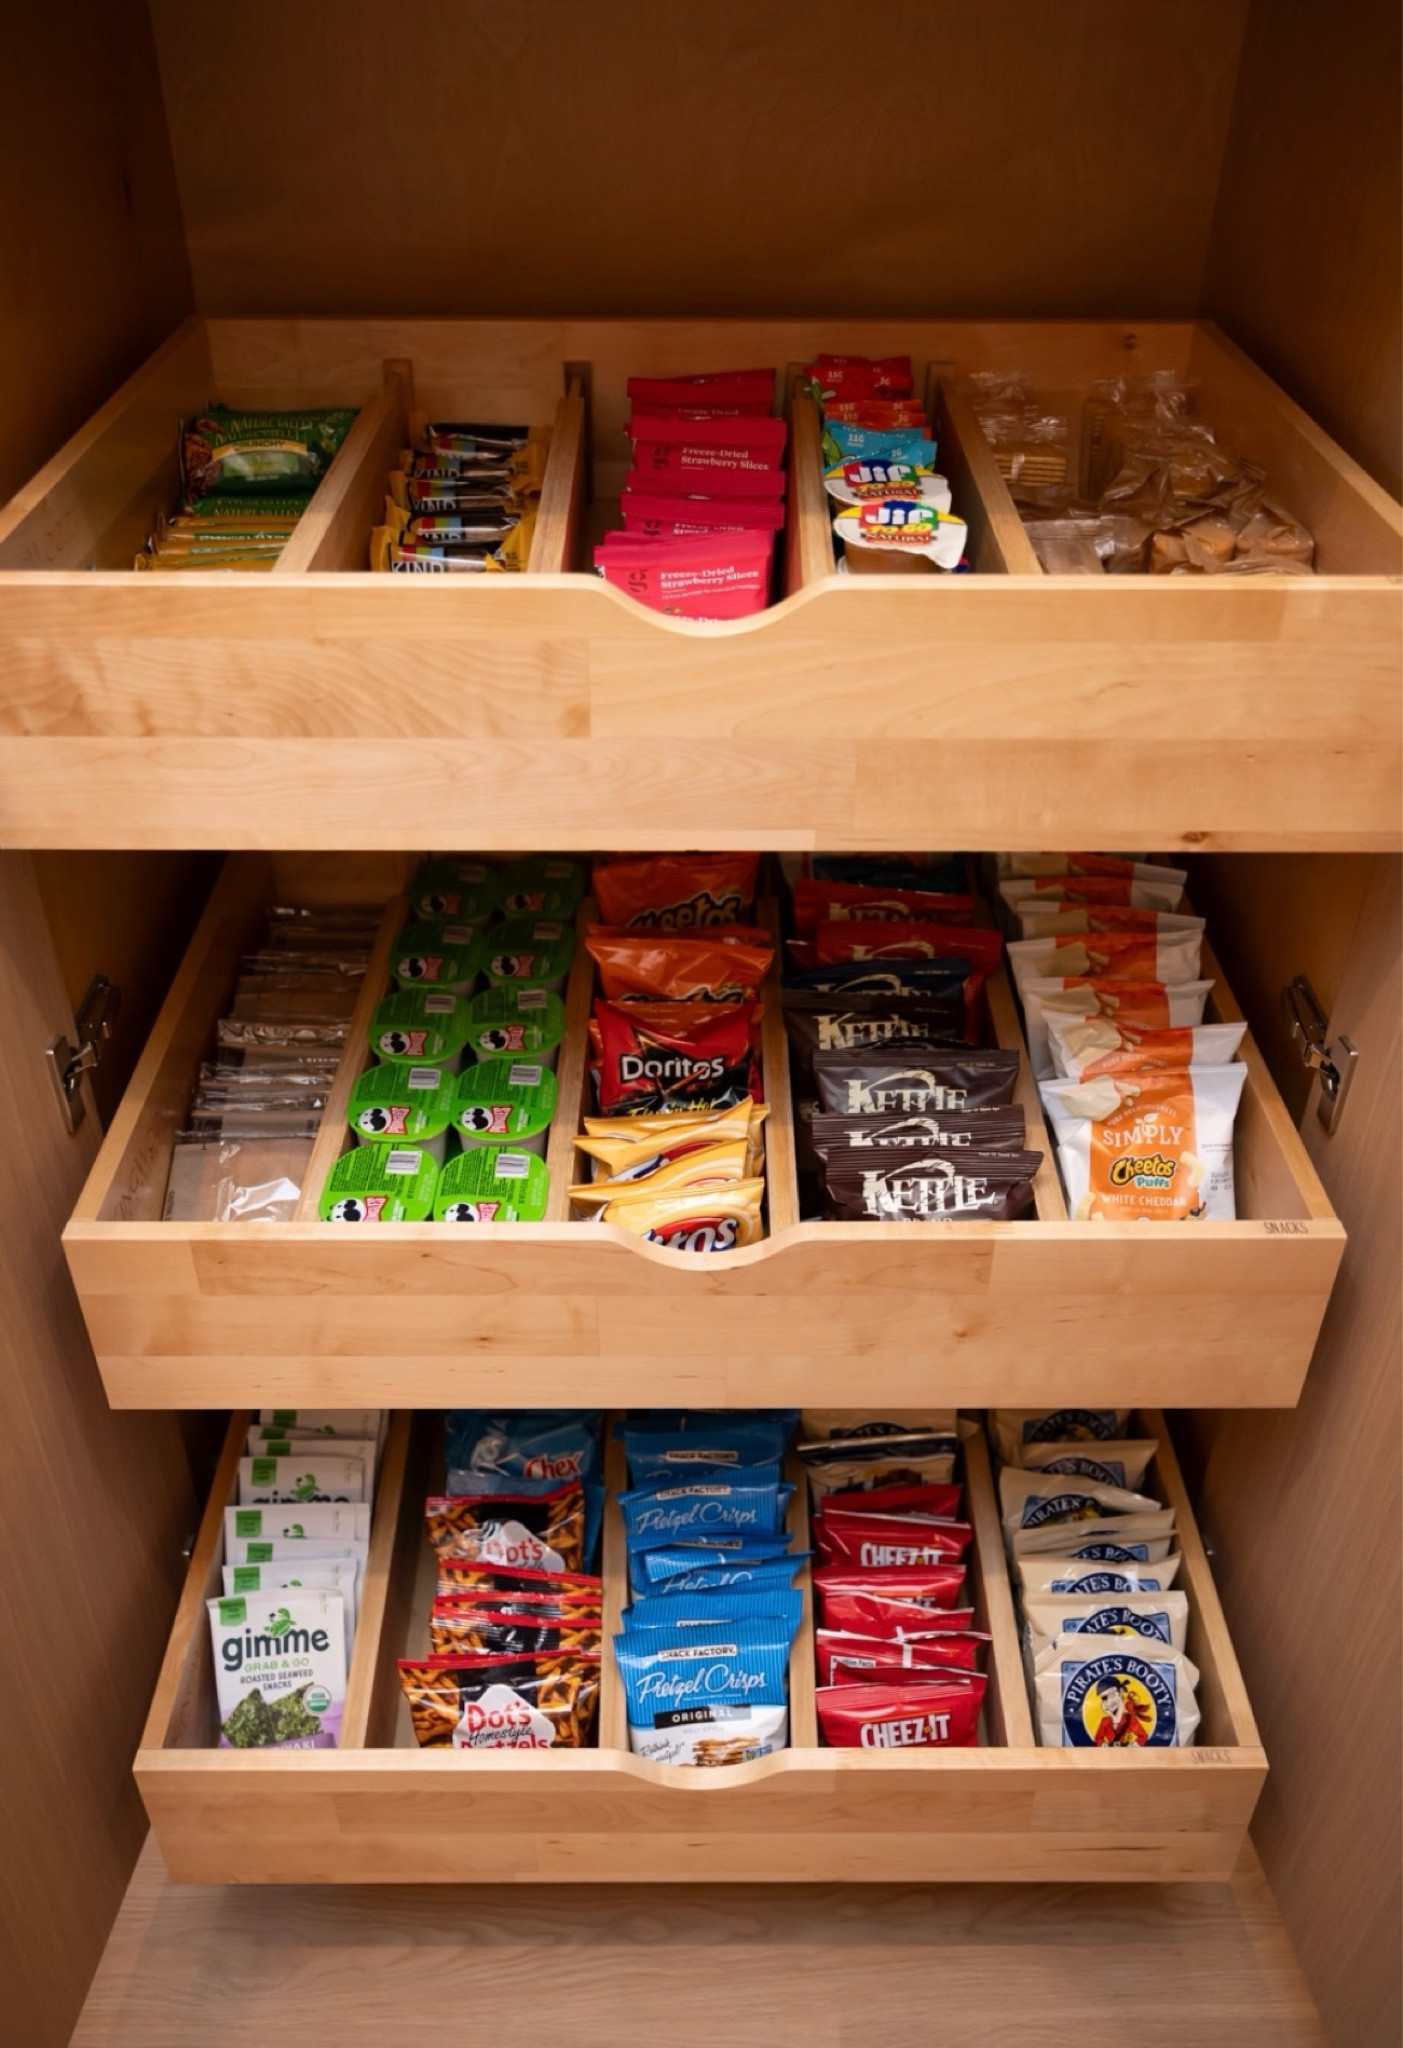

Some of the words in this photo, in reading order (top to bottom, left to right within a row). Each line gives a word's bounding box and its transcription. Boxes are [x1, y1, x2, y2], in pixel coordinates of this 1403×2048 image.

[681, 455, 738, 470] Strawberry
[739, 459, 770, 471] Slices
[620, 1055, 725, 1081] Doritos
[1102, 1123, 1184, 1148] SIMPLY
[1109, 1153, 1176, 1186] Cheetos
[1101, 1193, 1136, 1205] WHITE
[1138, 1195, 1187, 1207] CHEDDAR
[523, 1451, 583, 1480] Chex
[486, 1537, 543, 1563] Dot's
[222, 1627, 330, 1672] gimme
[661, 1650, 691, 1659] SNACK
[240, 1673, 276, 1685] ROASTED
[278, 1669, 314, 1681] SEAWEED
[245, 1660, 278, 1673] GRAB
[281, 1660, 290, 1669] &
[292, 1657, 310, 1667] GO
[263, 1681, 292, 1692] SNACKS
[635, 1667, 706, 1708] Pretzel
[704, 1663, 767, 1696] Crisps
[1066, 1658, 1122, 1703] PIRATE'S
[1126, 1660, 1173, 1705] BOOTY
[467, 1701, 532, 1732] Dot's
[671, 1709, 734, 1723] ORIGINAL
